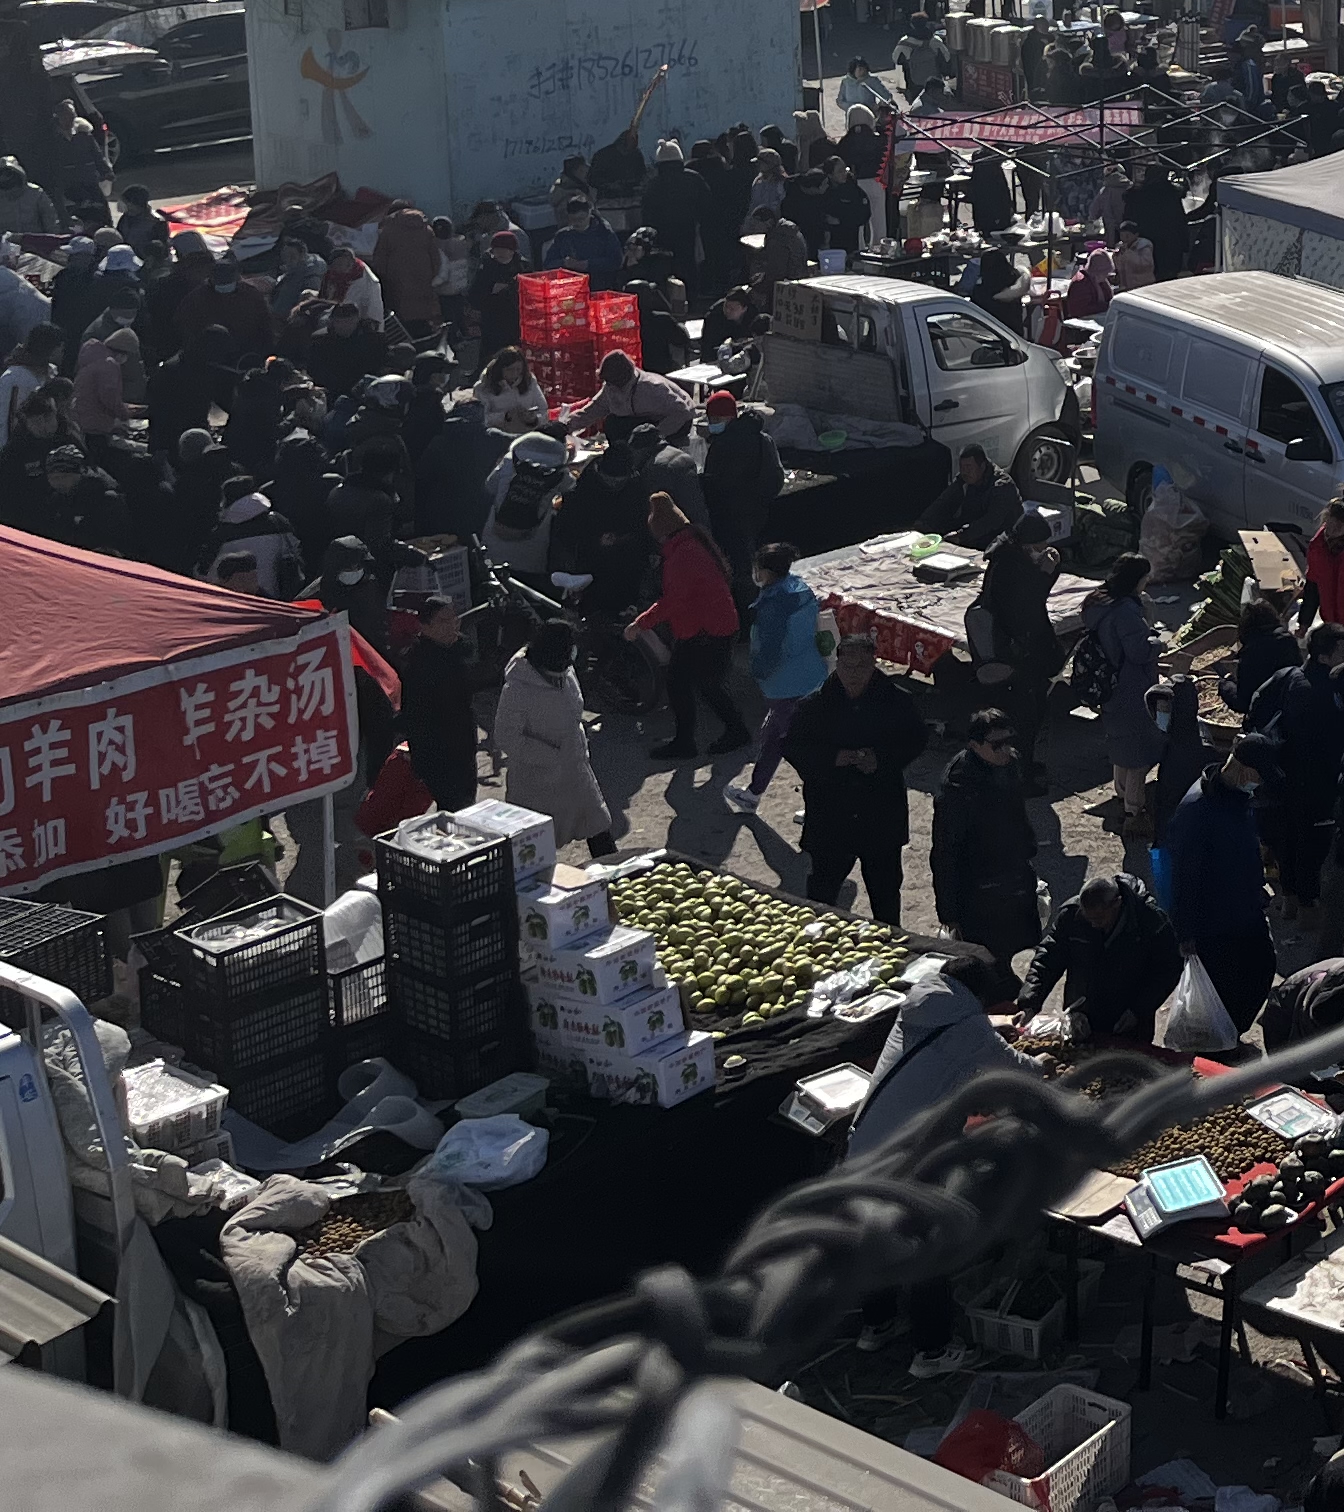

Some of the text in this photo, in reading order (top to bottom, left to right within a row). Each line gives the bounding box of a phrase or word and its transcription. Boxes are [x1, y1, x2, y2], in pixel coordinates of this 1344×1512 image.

[105, 728, 342, 845] 好喝忘不掉
